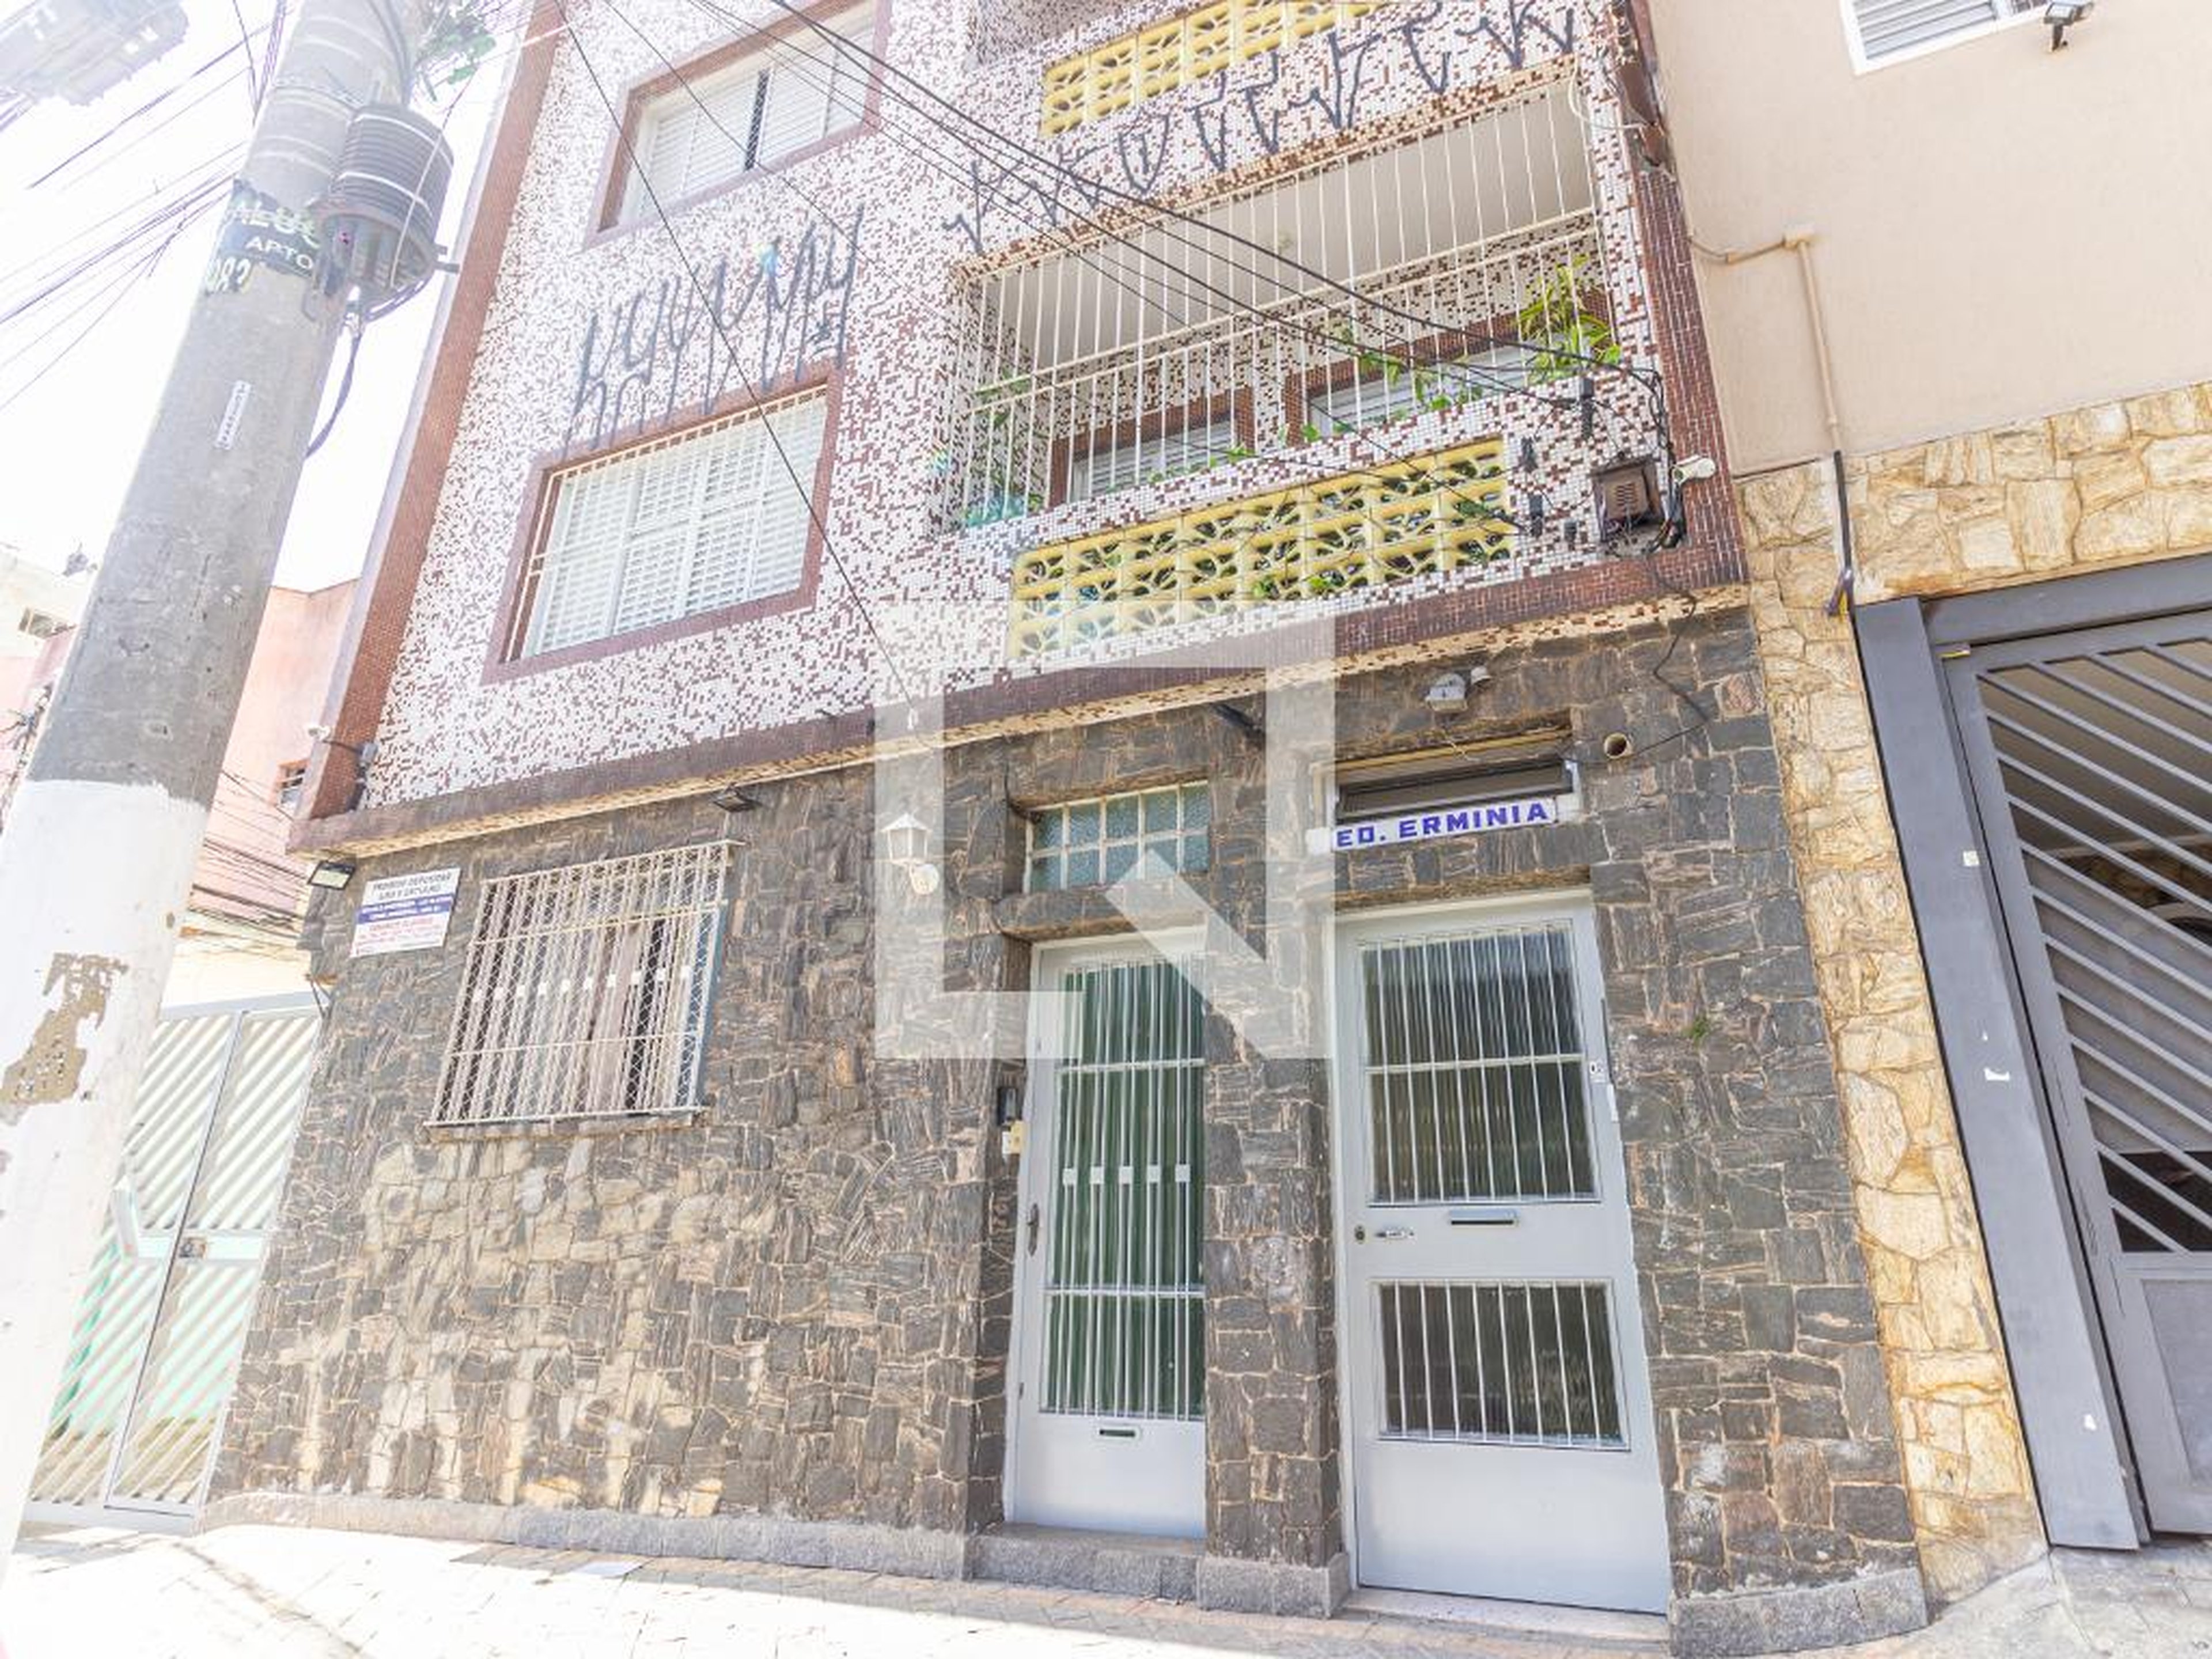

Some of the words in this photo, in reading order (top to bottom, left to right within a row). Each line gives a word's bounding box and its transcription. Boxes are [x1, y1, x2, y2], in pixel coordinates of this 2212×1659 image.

[245, 236, 313, 270] APTO
[1336, 825, 1386, 848] ED.
[1399, 802, 1548, 839] ERMINIA
